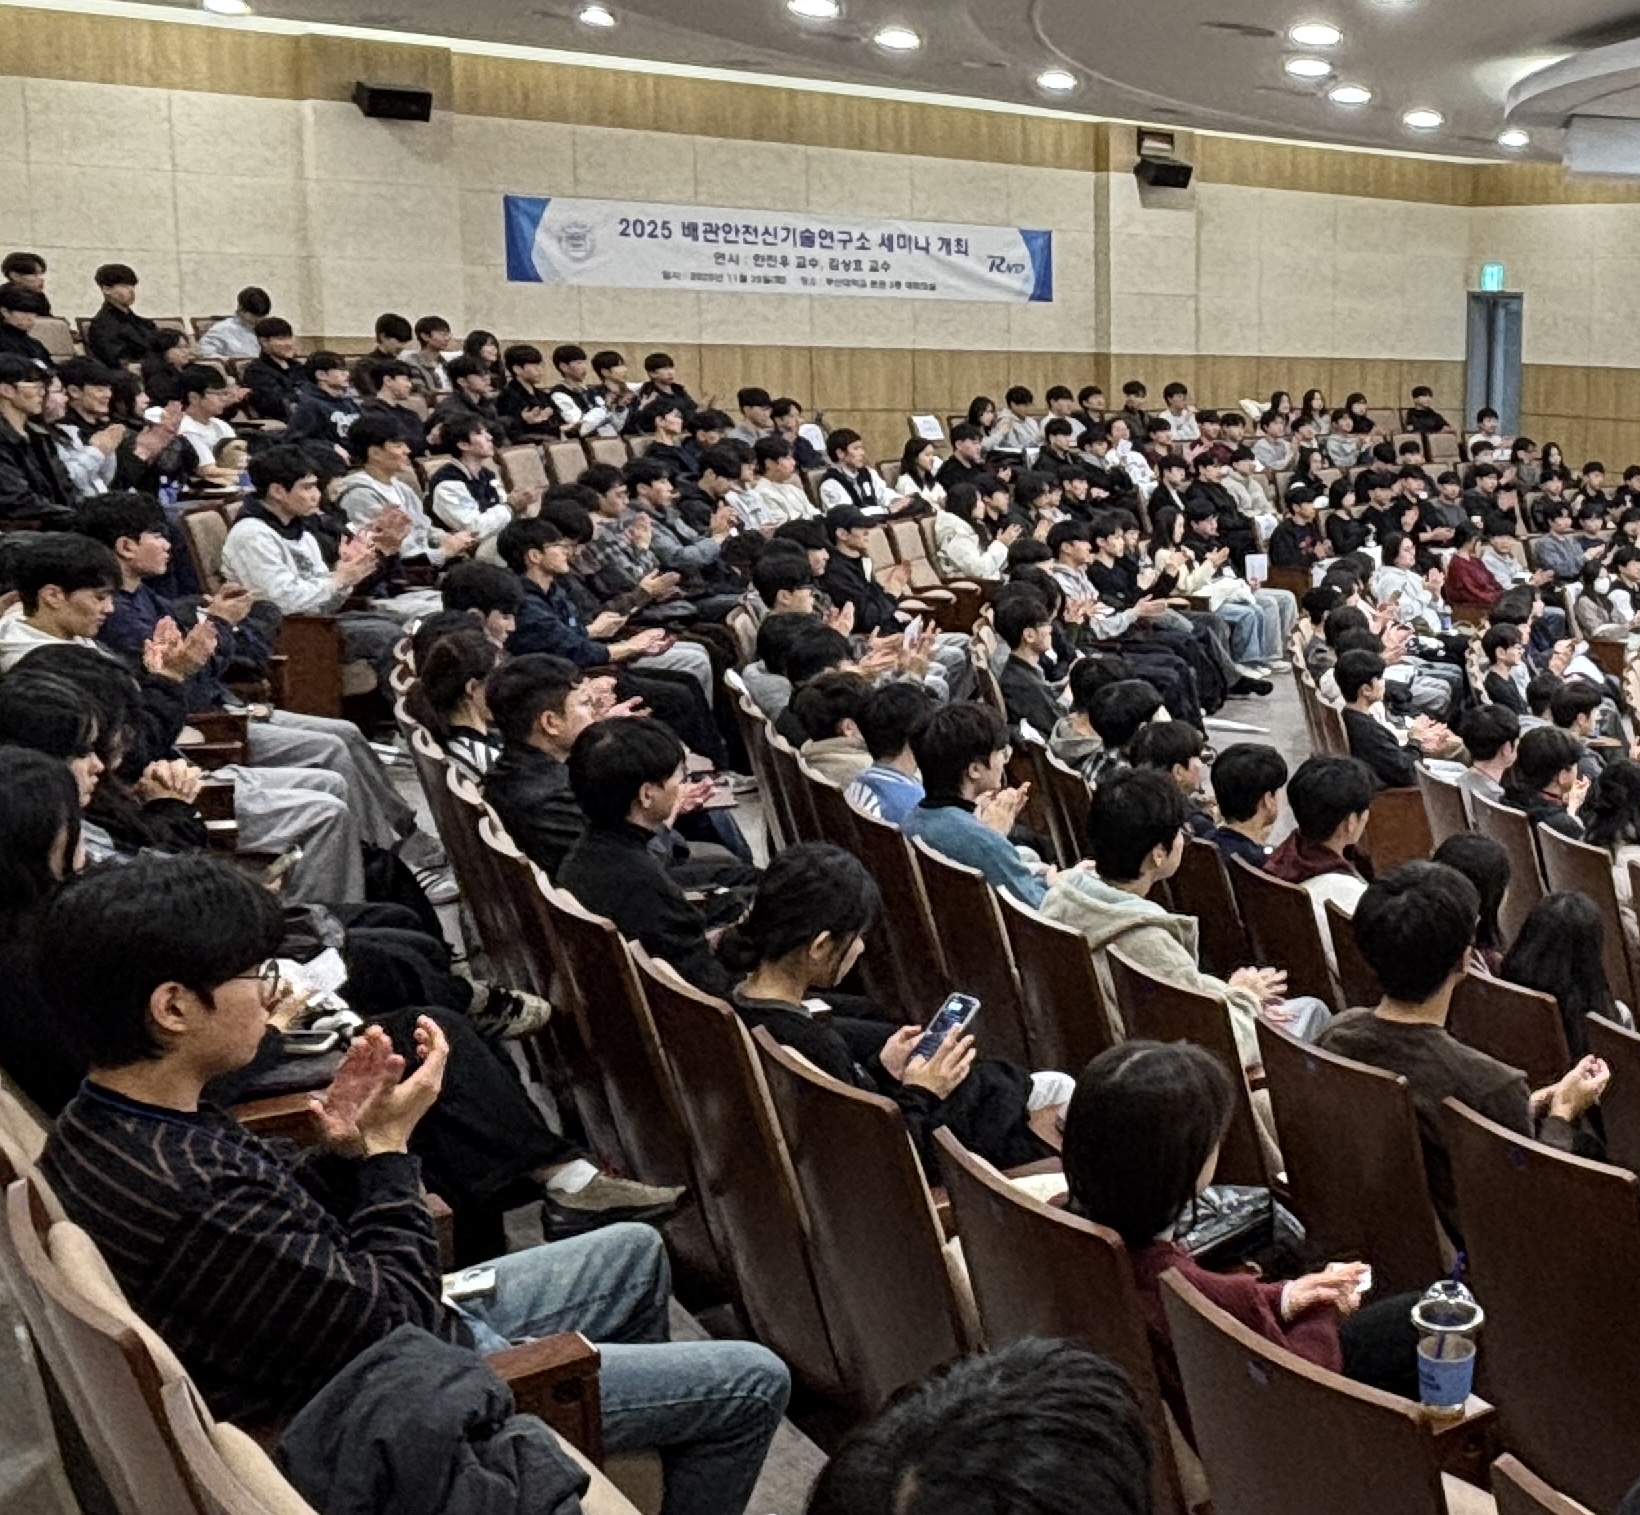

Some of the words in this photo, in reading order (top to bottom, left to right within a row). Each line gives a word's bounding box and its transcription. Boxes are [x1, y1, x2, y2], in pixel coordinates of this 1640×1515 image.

[618, 218, 672, 240] 2025
[681, 221, 871, 250] 배관안전신기술연구소
[878, 232, 931, 255] 세미나
[937, 236, 969, 257] 개최
